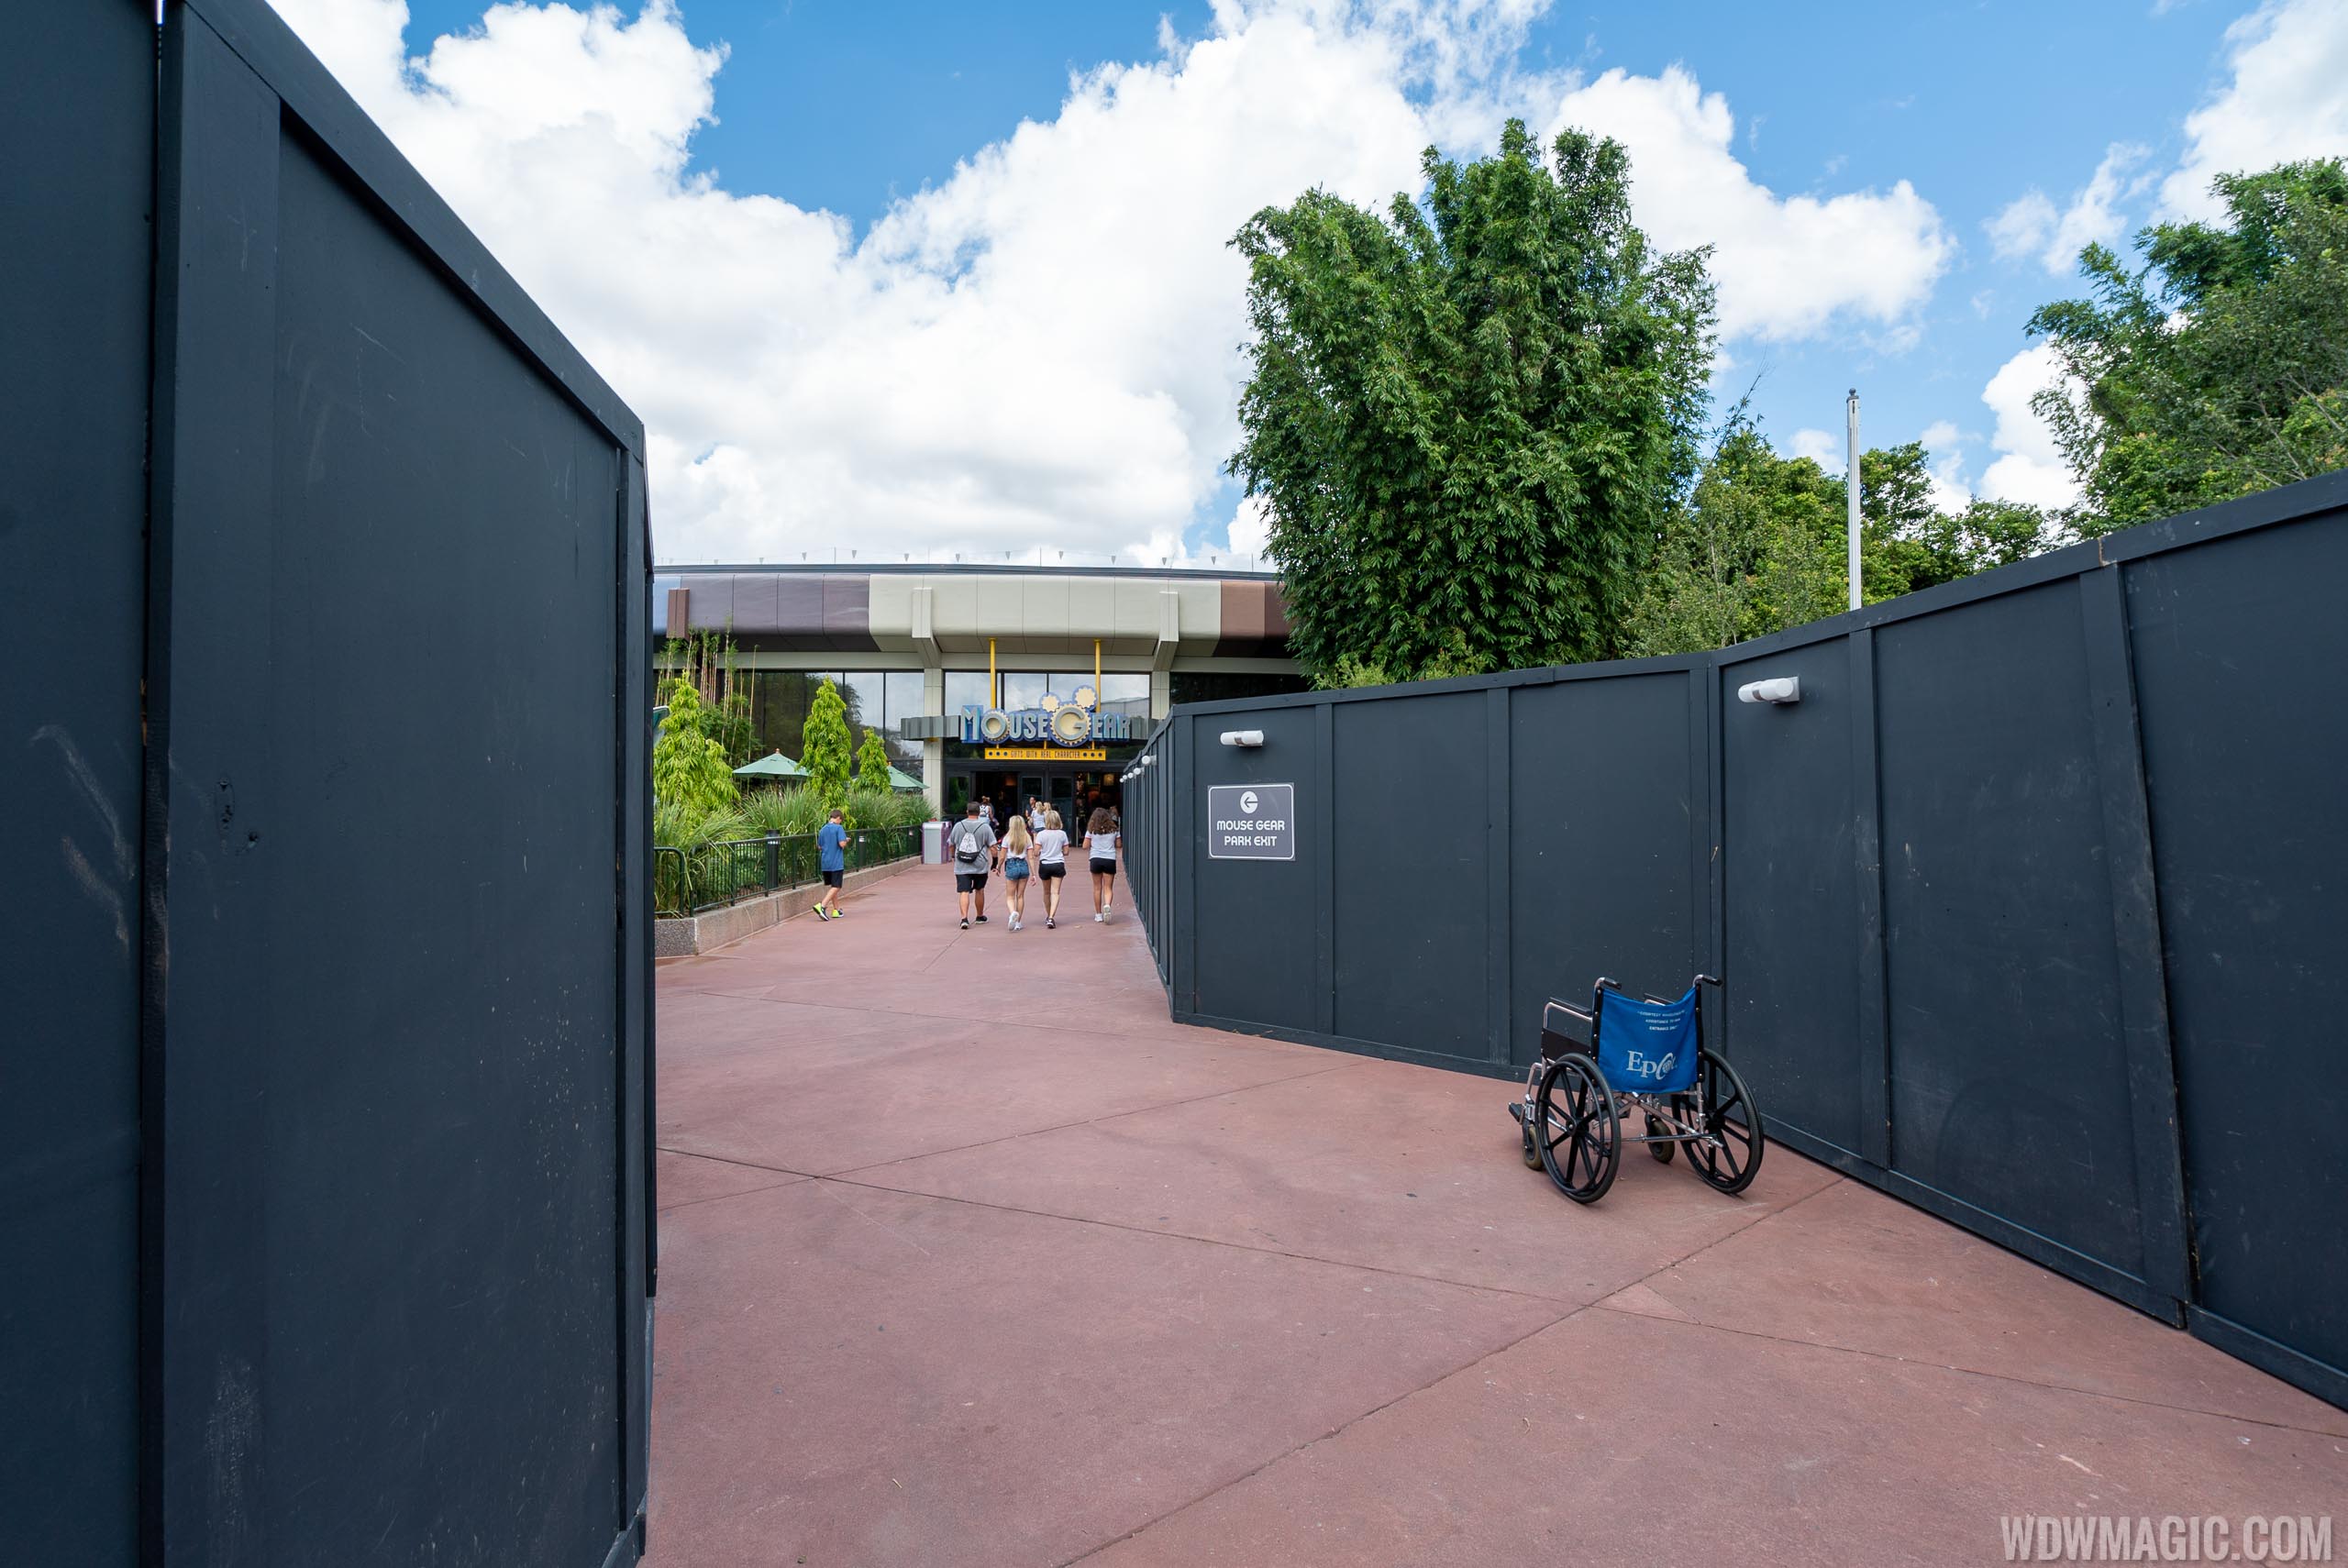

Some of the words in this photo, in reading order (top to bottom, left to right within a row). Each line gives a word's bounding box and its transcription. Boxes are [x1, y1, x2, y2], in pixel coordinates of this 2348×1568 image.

[1216, 820, 1254, 831] MOUSE
[1256, 820, 1285, 831] GEAR
[1224, 835, 1252, 846] PARK
[1254, 835, 1277, 846] EXIT
